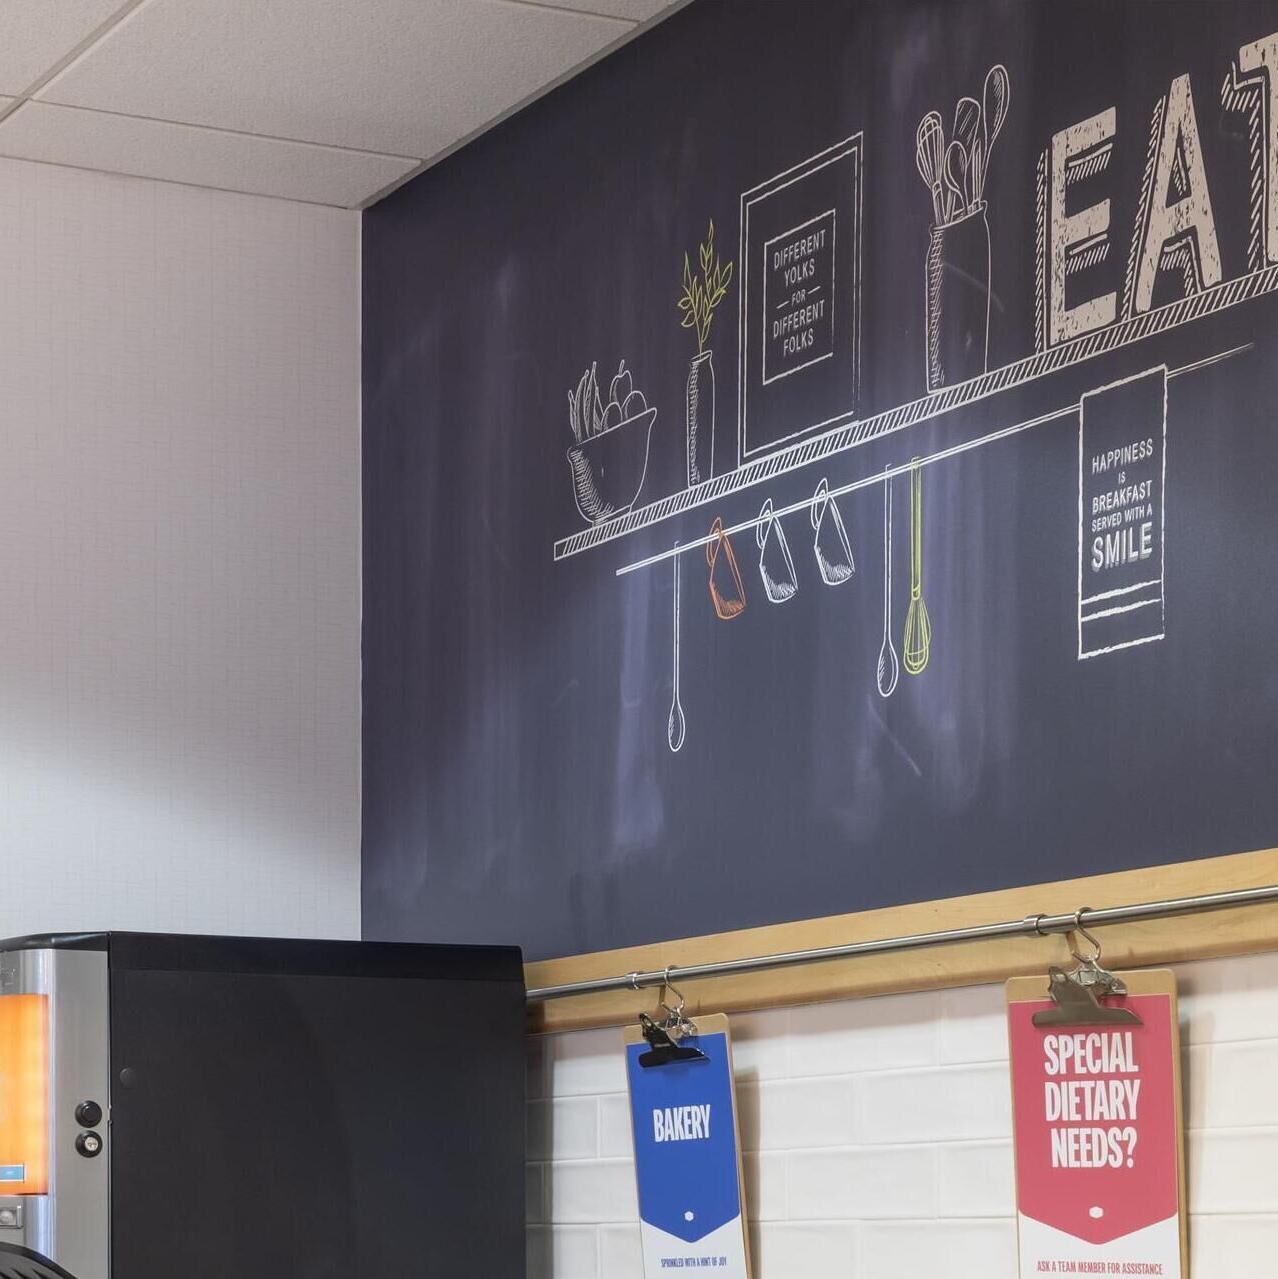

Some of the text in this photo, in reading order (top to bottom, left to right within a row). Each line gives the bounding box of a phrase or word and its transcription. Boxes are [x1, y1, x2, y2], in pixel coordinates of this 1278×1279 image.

[774, 229, 826, 270] DIFFERENT
[784, 258, 815, 287] YOLKS
[791, 289, 806, 306] FOR
[773, 299, 825, 339] DIFFERENT
[783, 328, 814, 357] FOLKS
[1092, 438, 1153, 474] HAPPINESS
[1118, 471, 1126, 484] IS
[1092, 480, 1153, 515] BREAKFAST
[1091, 503, 1153, 533] SERVED WITH A
[1091, 522, 1153, 572] SMILE
[1043, 1031, 1139, 1075] SPECIAL
[1044, 1079, 1141, 1122] DIETARY
[653, 1104, 711, 1142] BAKERY
[1051, 1126, 1137, 1169] NEEDS?
[661, 1258, 684, 1268] SPRINKLED
[684, 1257, 696, 1267] WITH
[719, 1255, 727, 1266] JOY
[1037, 1260, 1051, 1272] ASK
[1057, 1261, 1076, 1273] TEAM
[1078, 1261, 1106, 1274] MEMBER
[1108, 1262, 1120, 1274] FOR
[1121, 1262, 1163, 1275] ASSISTANCE
